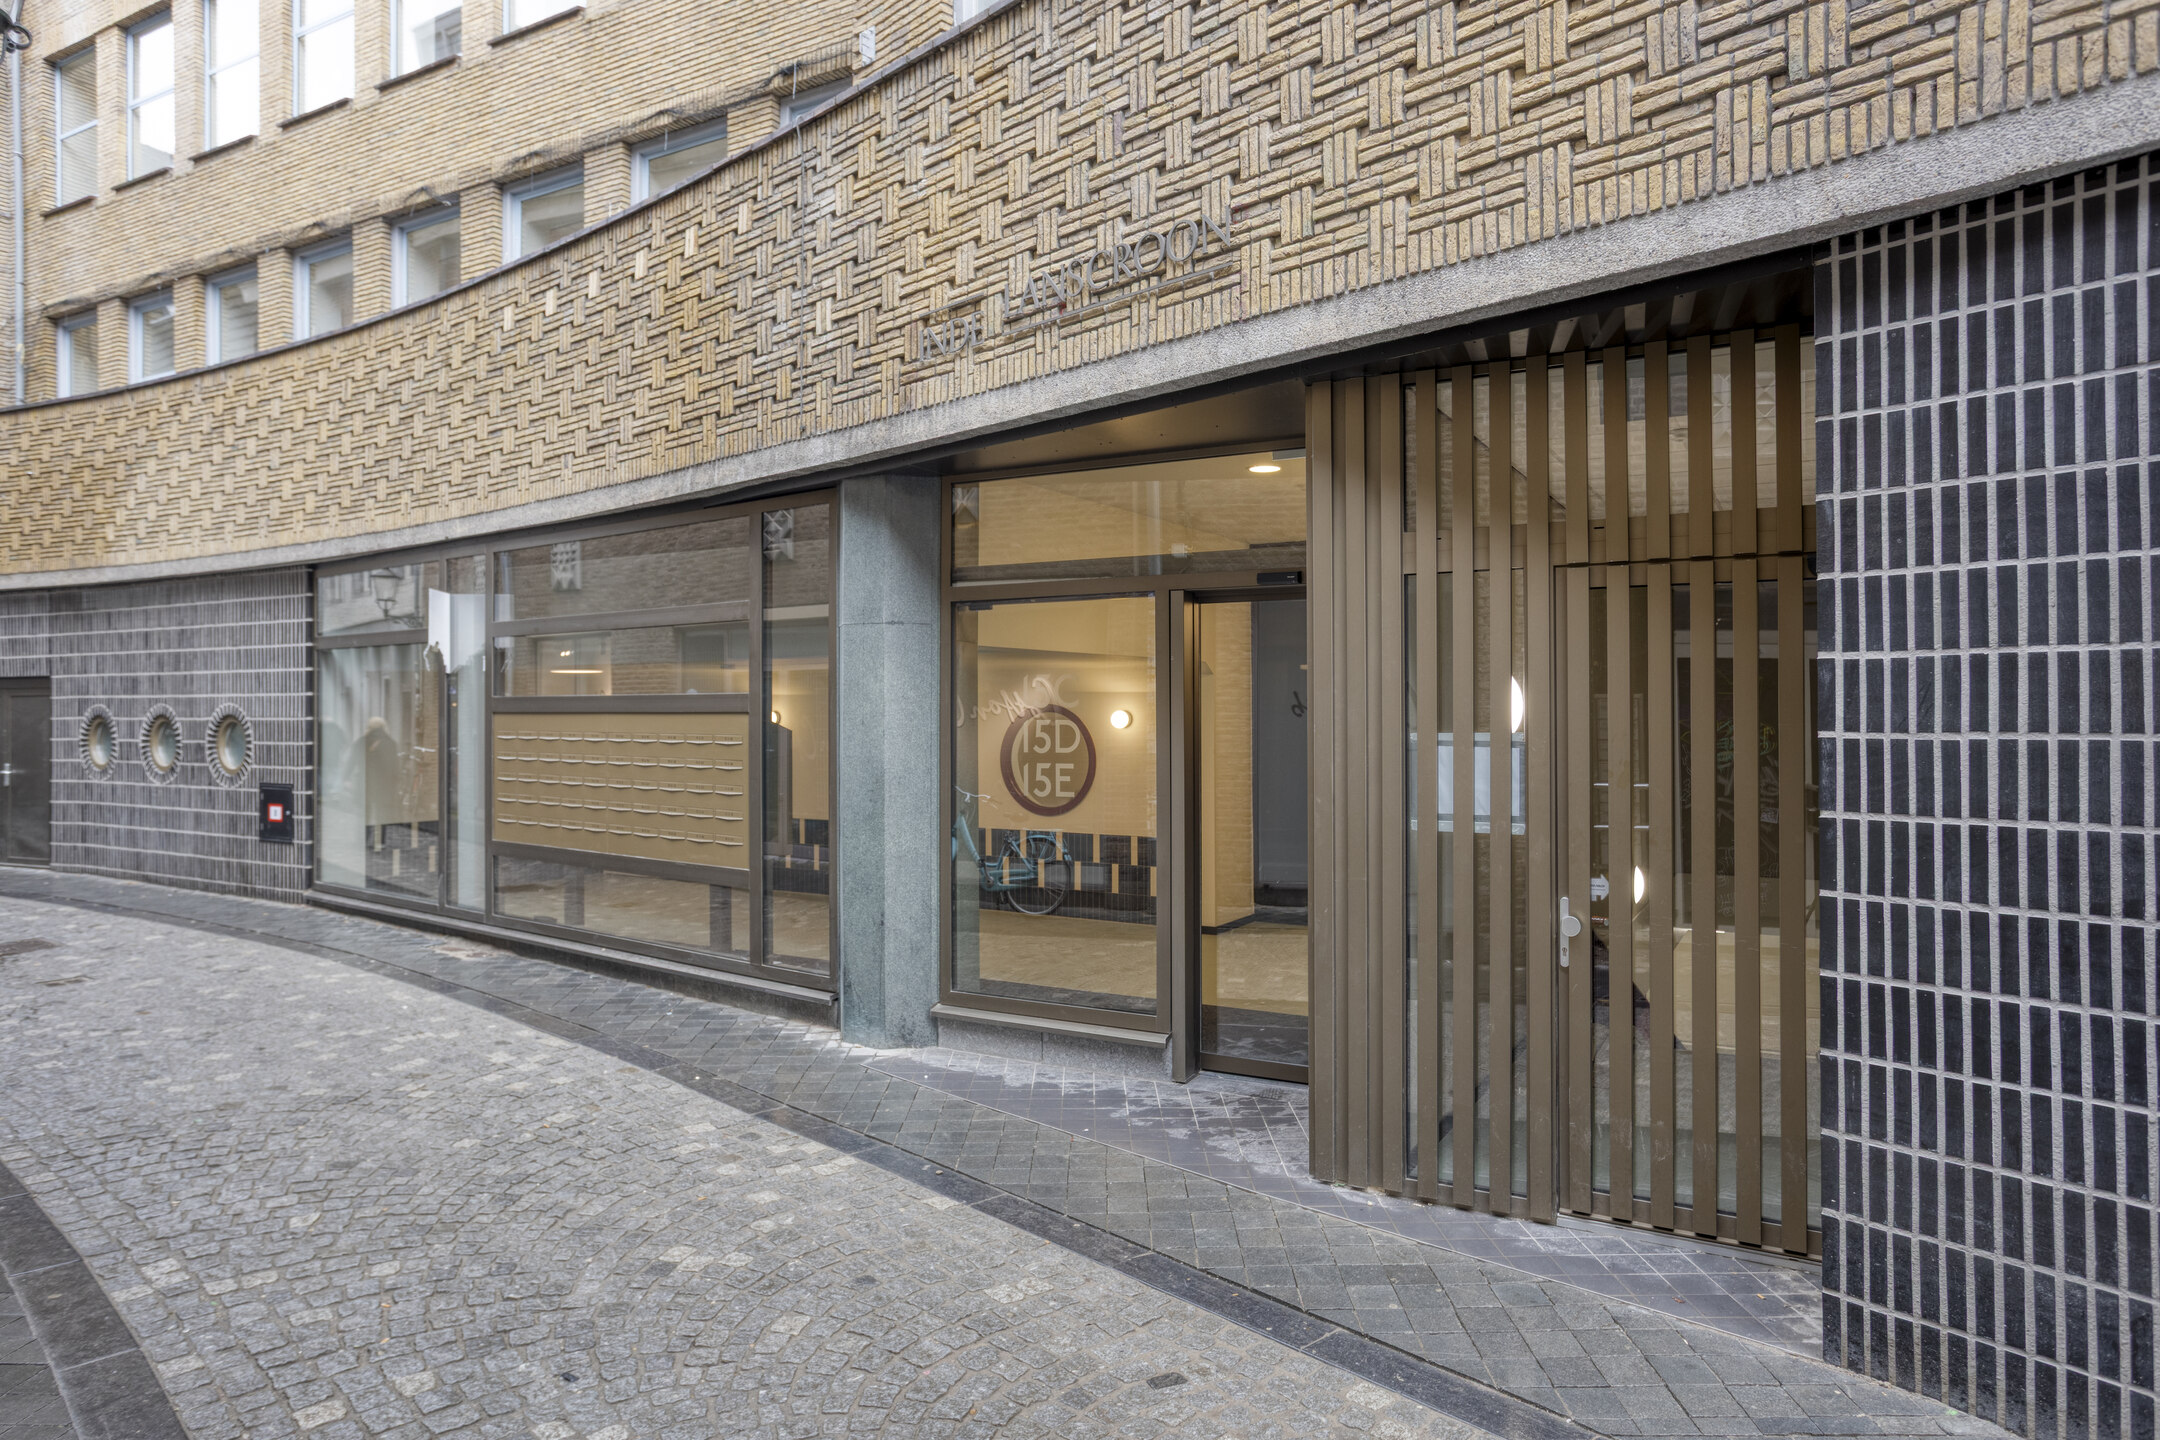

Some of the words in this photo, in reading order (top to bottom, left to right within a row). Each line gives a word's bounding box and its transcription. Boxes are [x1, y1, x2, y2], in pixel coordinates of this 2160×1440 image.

[1003, 205, 1232, 318] LANSCROON
[1022, 719, 1081, 753] 15D
[1022, 762, 1075, 798] 15E
